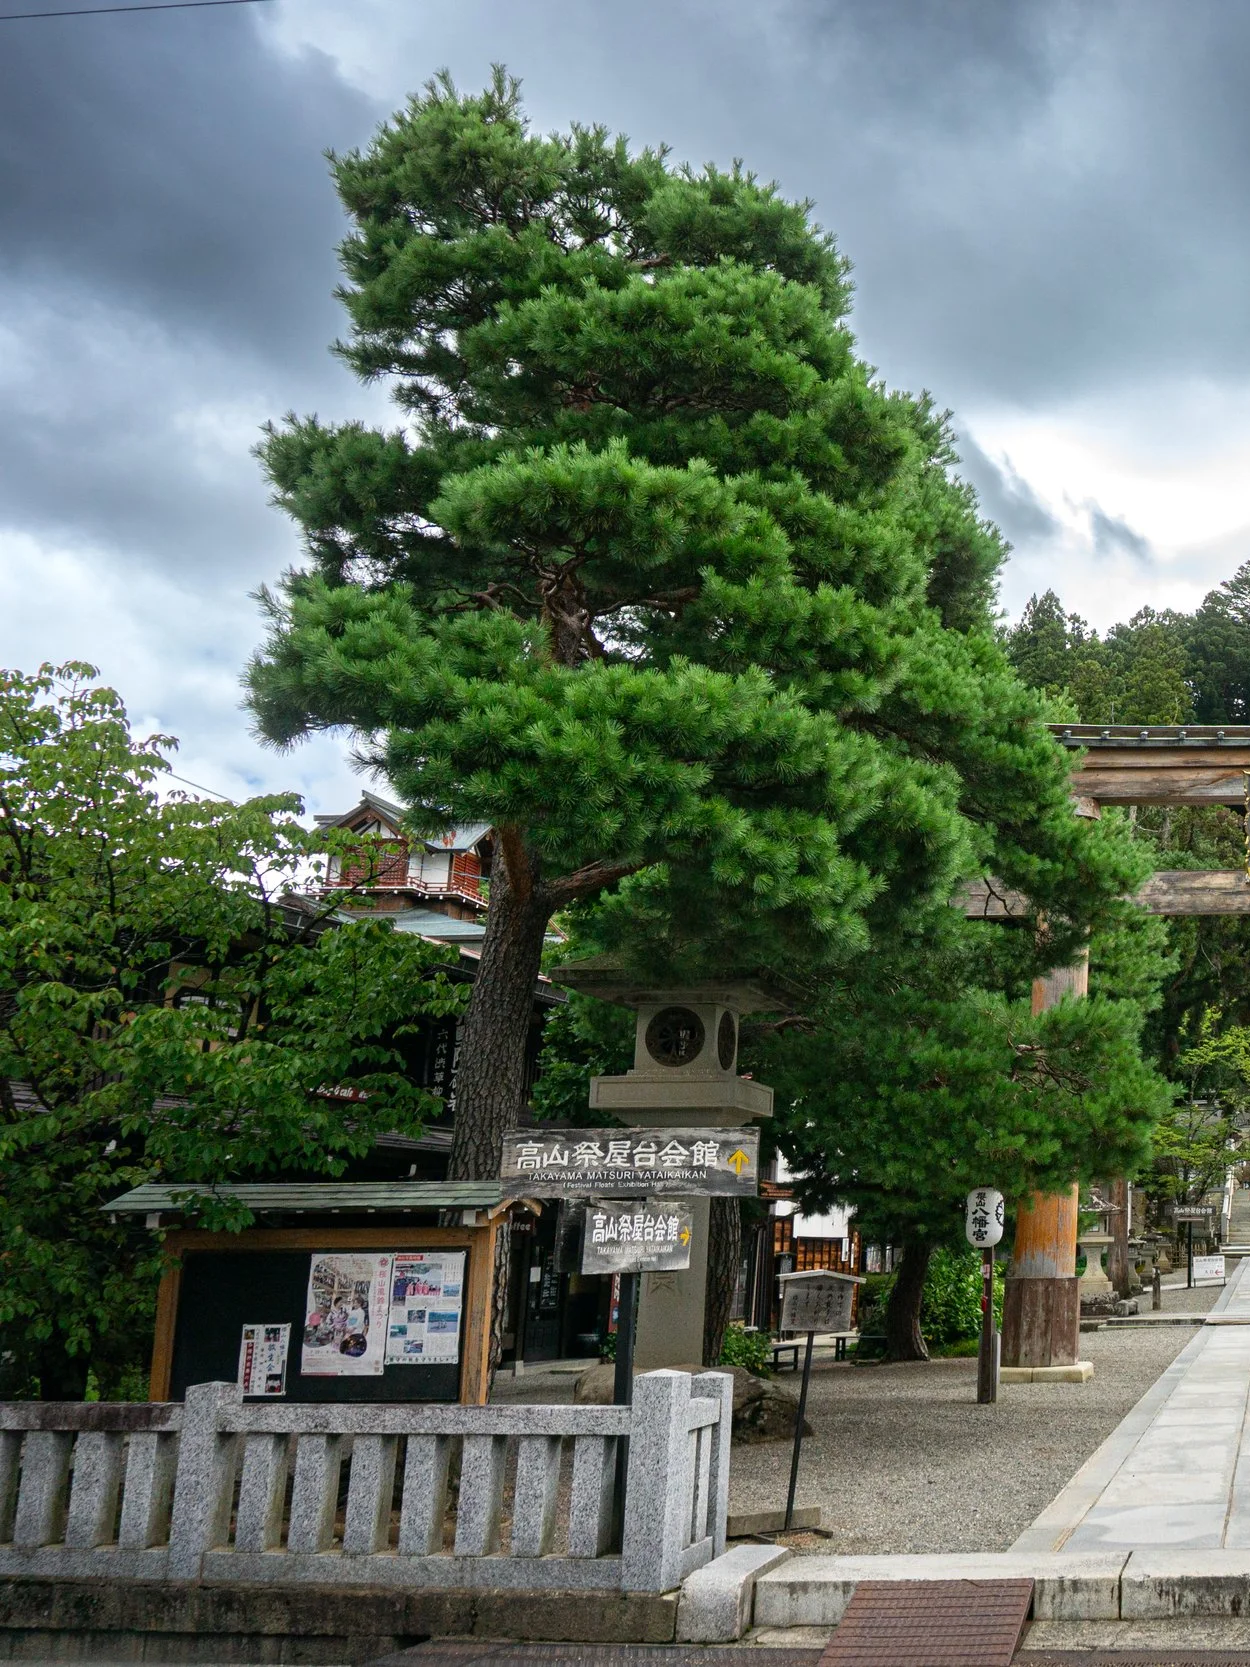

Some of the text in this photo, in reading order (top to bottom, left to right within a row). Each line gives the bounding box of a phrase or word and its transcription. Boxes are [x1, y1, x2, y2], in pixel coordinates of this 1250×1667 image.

[516, 1140, 720, 1170] 高山祭屋台会館
[528, 1170, 707, 1181] TAKAYAMA MATSURI YATAIKAIKAN
[592, 1212, 680, 1243] 高山祭屋台会館
